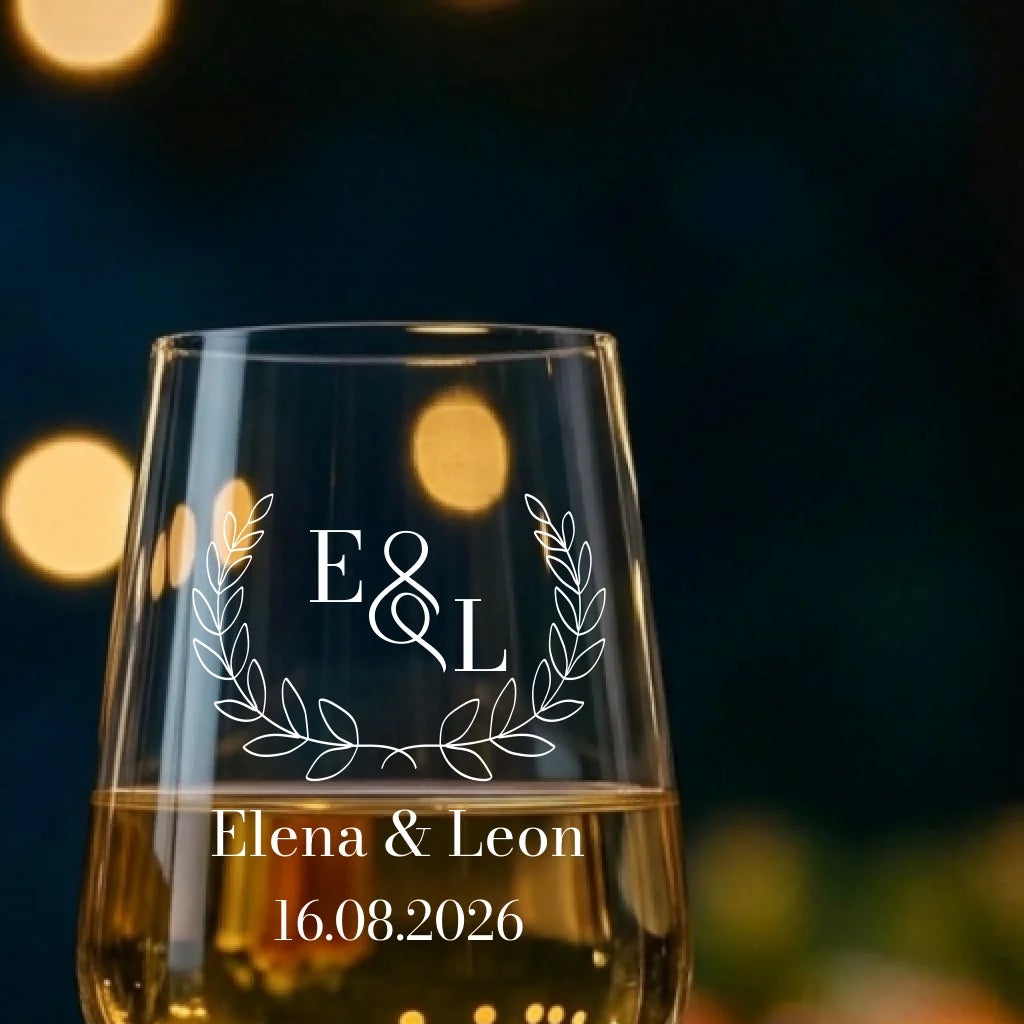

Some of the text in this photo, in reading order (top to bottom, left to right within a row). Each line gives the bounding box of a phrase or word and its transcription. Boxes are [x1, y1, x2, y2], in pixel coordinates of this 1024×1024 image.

[309, 529, 507, 672] E & L
[211, 808, 585, 857] Elena & Leon
[274, 899, 524, 941] 16.08.2026
